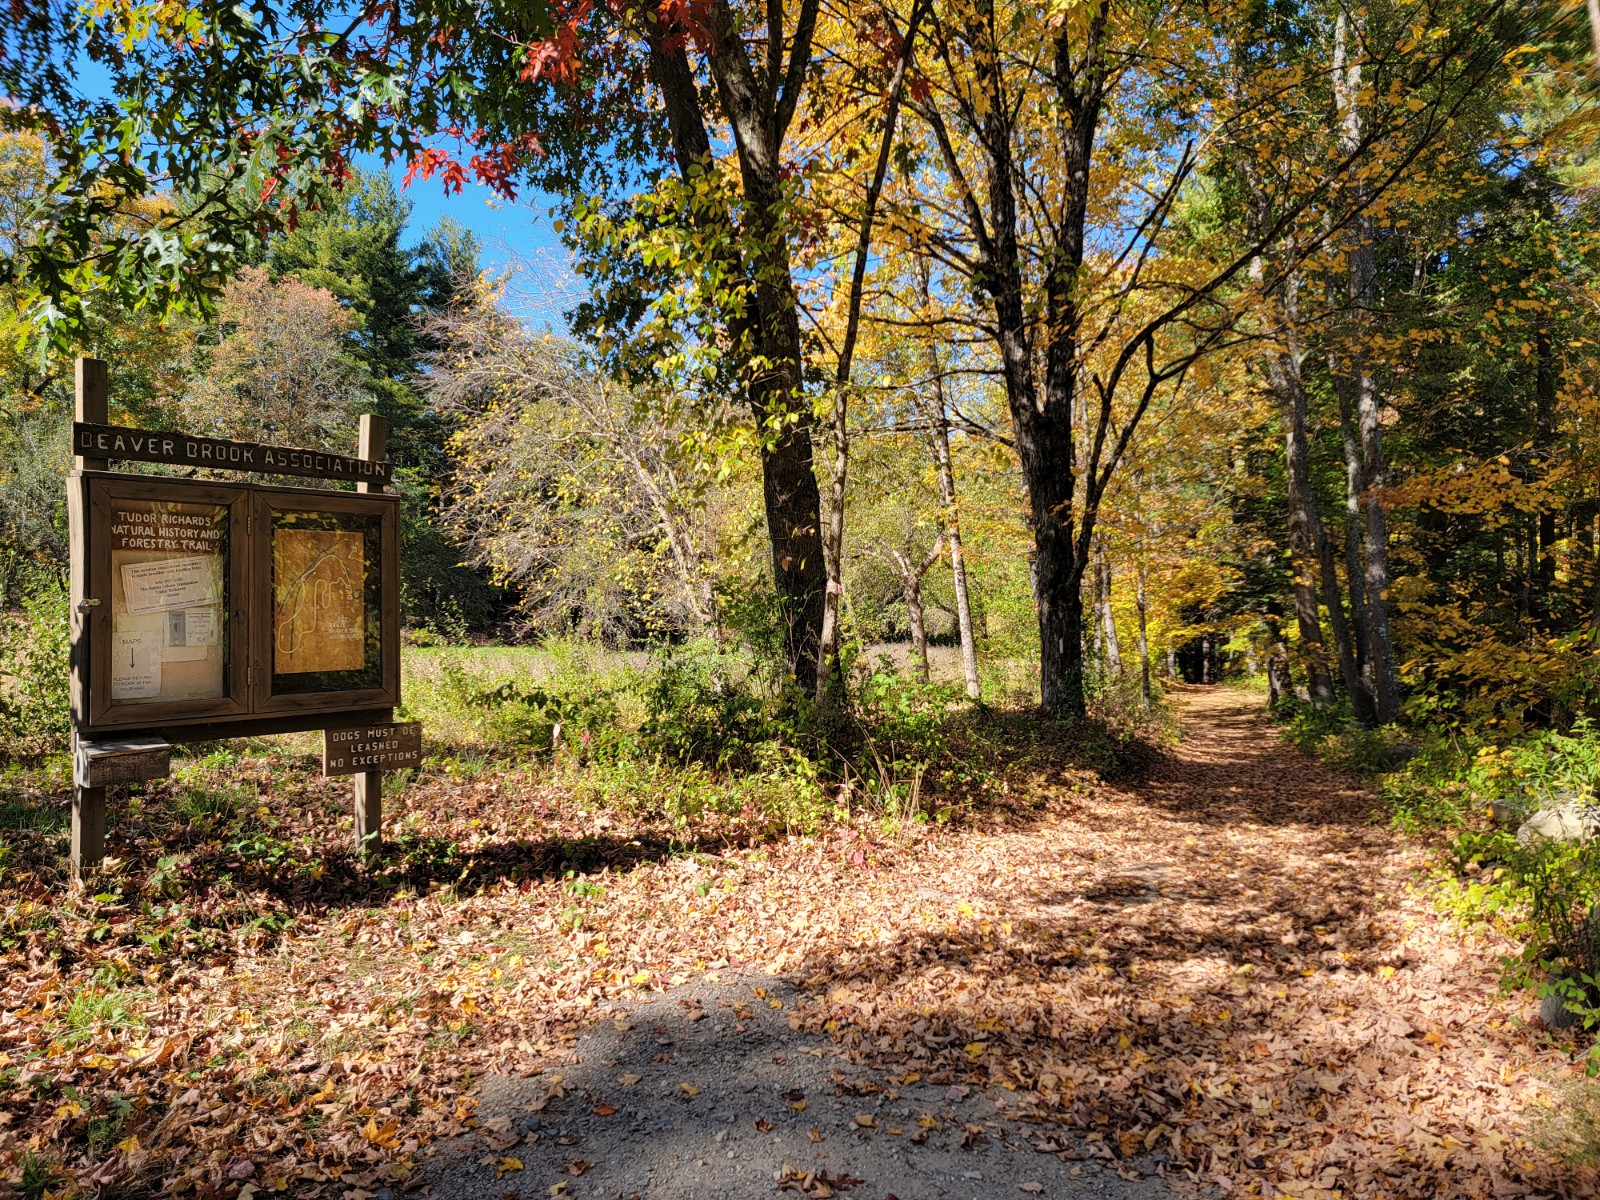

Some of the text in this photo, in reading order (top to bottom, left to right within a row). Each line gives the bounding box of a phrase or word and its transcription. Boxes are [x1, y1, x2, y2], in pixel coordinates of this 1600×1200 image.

[81, 431, 385, 476] BEAVER BROOK ASSOCIATION
[118, 512, 211, 526] TUDOR RICHARDS
[111, 524, 219, 539] NATURAL HISTORY AND
[122, 538, 211, 551] FORESTRY TRAIL
[333, 731, 360, 741] DOGS
[368, 728, 395, 738] MUST
[351, 741, 398, 753] LEASHED
[330, 751, 418, 768] NO EXCEPTIONS
